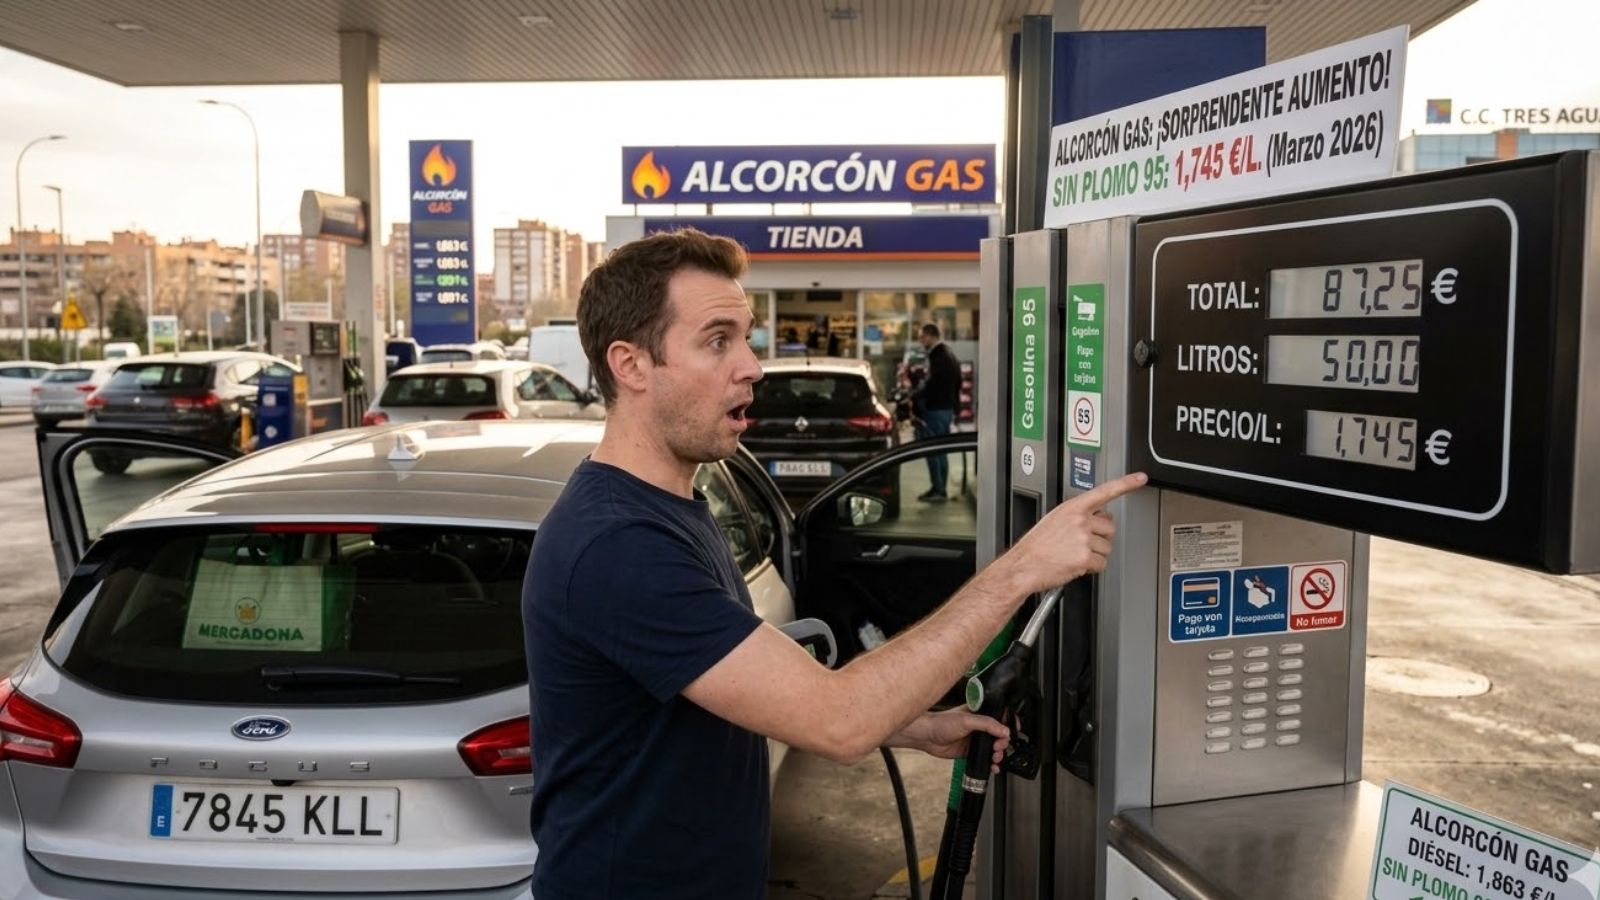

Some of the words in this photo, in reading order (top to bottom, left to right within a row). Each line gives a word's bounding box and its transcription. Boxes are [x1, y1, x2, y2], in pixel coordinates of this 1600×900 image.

[1055, 118, 1121, 167] ALCORCÓN
[1123, 116, 1153, 151] GAS:
[1157, 79, 1285, 150] ¡SORPRENDENTE
[1287, 49, 1392, 112] AUMENTO!
[1460, 108, 1495, 125] C.C.
[1502, 108, 1550, 124] TRES
[1556, 108, 1600, 124] AGU
[681, 152, 897, 192] ALCORCÓN
[905, 159, 985, 191] GAS
[1053, 174, 1078, 207] SIN
[1082, 160, 1139, 203] PLOMO
[1143, 154, 1169, 192] 95:
[1175, 142, 1224, 192] 1,745
[1229, 135, 1262, 176] €/L.
[1266, 131, 1324, 177] (Marzo
[1329, 110, 1384, 159] 2026)
[428, 202, 452, 213] GAS
[767, 226, 863, 248] TIENDA
[1187, 281, 1260, 311] TOTAL:
[1323, 264, 1421, 315] 87,25
[1431, 267, 1459, 305] €
[1022, 298, 1036, 326] 95
[1178, 344, 1258, 375] LITROS:
[1323, 339, 1420, 387] 50,00
[1176, 405, 1282, 444] PRECIO/L:
[1335, 417, 1415, 462] 1,745
[1425, 429, 1453, 466] €
[198, 623, 304, 640] MERCADONA
[1296, 616, 1309, 626] No
[157, 816, 165, 827] E
[182, 792, 286, 833] 7845
[303, 795, 383, 836] KLL
[1410, 807, 1518, 864] ALCORCÓN
[1524, 848, 1569, 883] GAS
[1382, 857, 1408, 882] SIN
[1412, 869, 1468, 900] PLOMO
[1408, 837, 1471, 878] DIÉSEL:
[1477, 865, 1525, 899] 1,863
